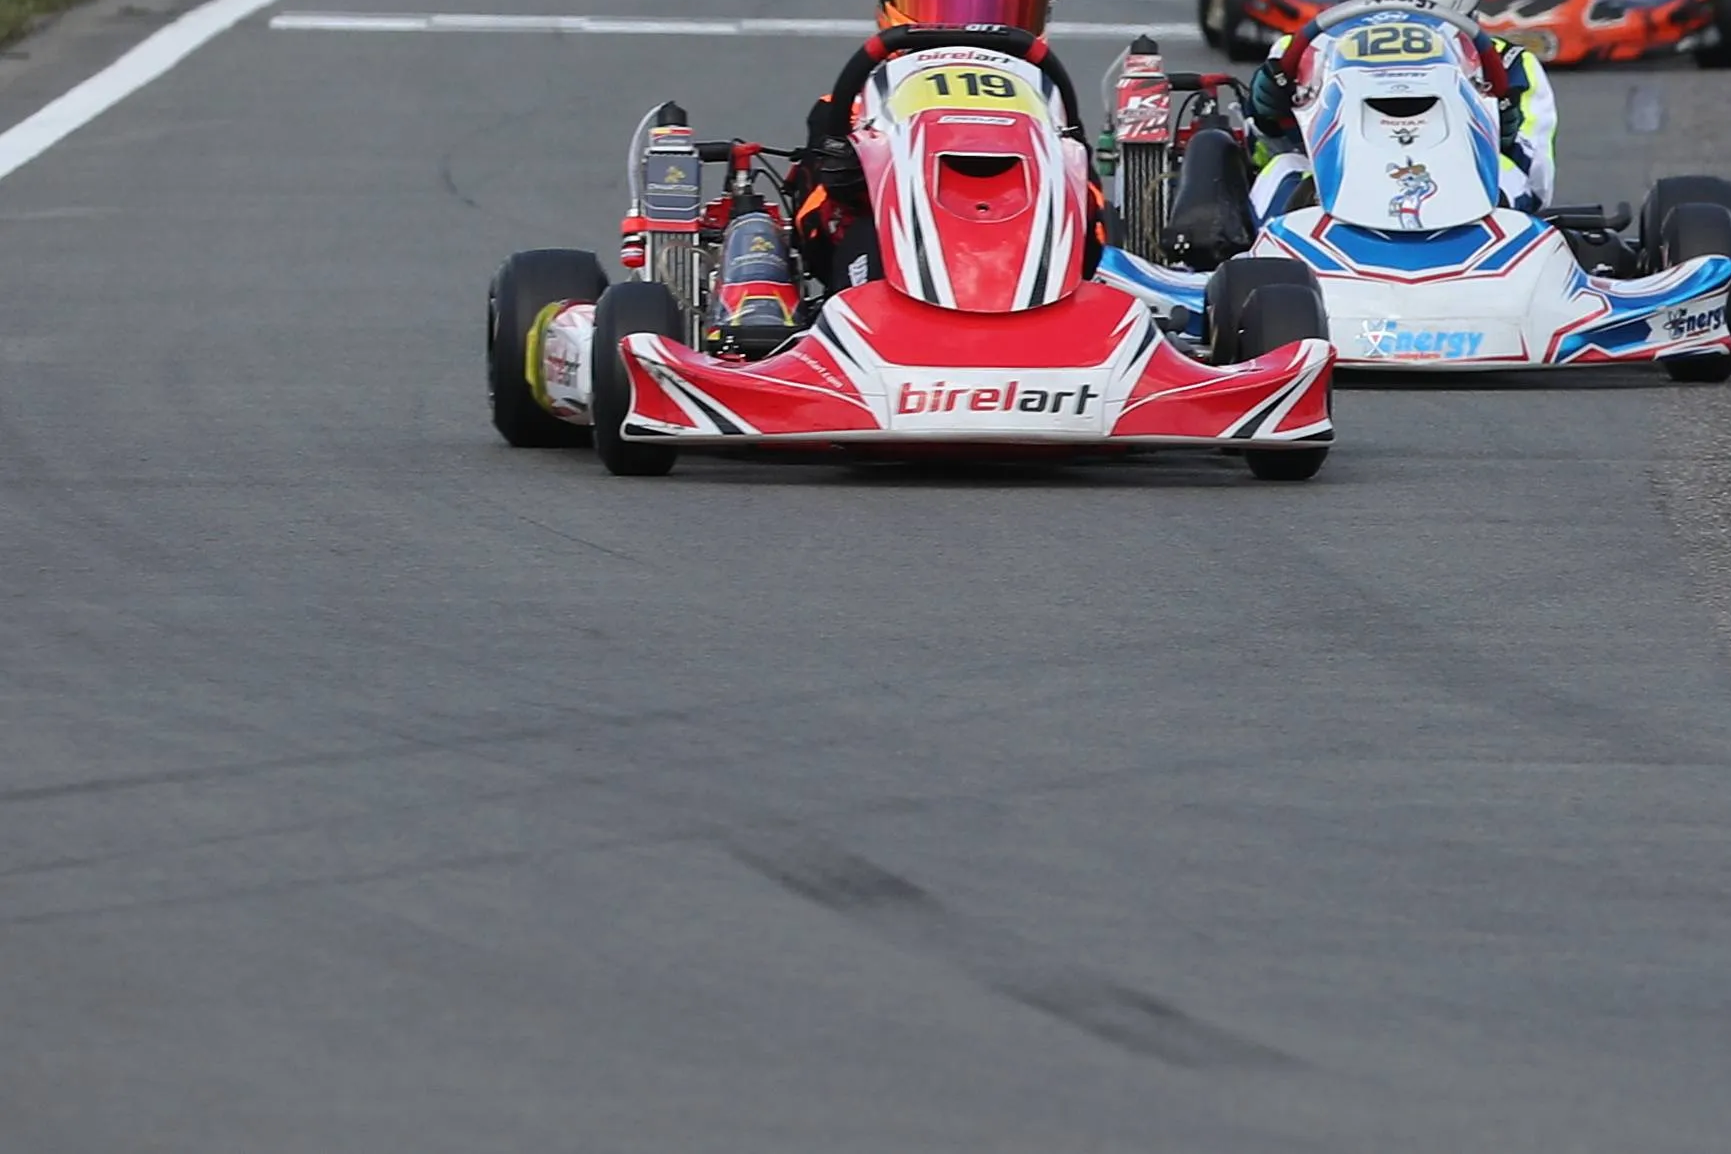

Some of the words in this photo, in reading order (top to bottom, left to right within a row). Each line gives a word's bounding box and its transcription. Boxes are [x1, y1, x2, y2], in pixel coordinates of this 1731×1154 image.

[917, 50, 1016, 64] birelart
[1351, 27, 1433, 57] 128
[926, 72, 1017, 98] 119
[1355, 319, 1484, 358] Energy
[896, 380, 1099, 415] birelart
